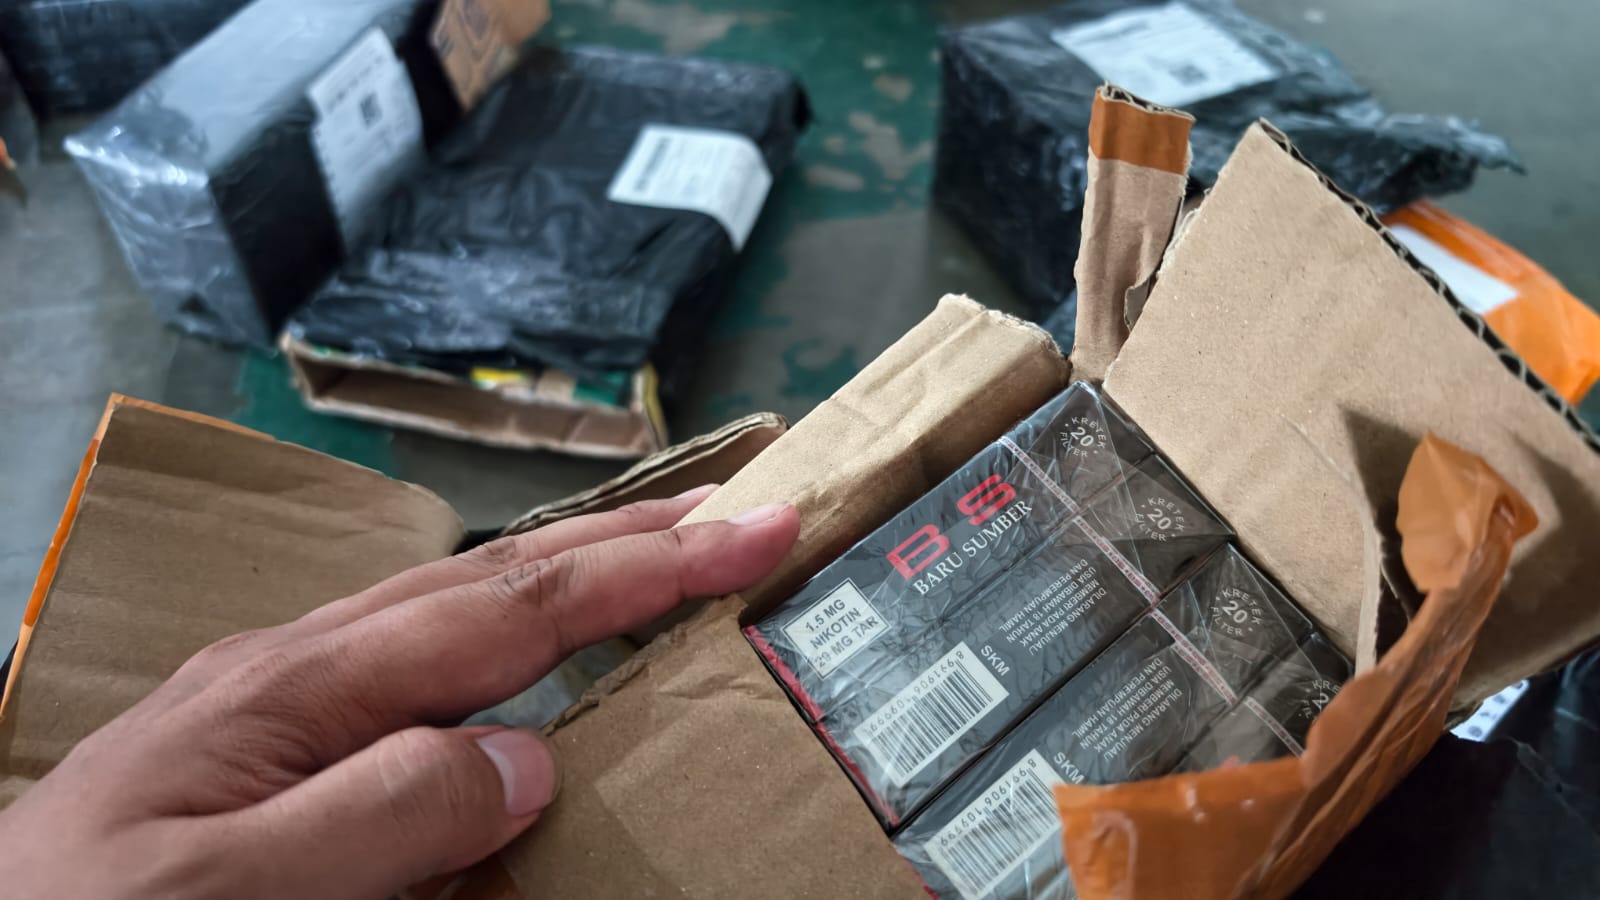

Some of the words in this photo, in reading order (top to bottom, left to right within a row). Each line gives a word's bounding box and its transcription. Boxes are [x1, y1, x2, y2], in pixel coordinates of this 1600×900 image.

[1070, 426, 1094, 447] 20
[1071, 416, 1107, 449] KRETEK
[1147, 497, 1185, 532] KRETEK
[1147, 508, 1172, 530] 20
[912, 552, 964, 595] BARU
[962, 500, 1033, 558] SUMBER
[1069, 559, 1088, 576] DAN
[1077, 566, 1096, 584] USIA
[1023, 574, 1072, 615] PEREMPUAN
[1042, 581, 1079, 613] DIBAWAH
[1064, 579, 1100, 610] MEMBERI
[1067, 587, 1107, 623] DILARANG
[1221, 588, 1263, 625] KRETEK
[805, 614, 825, 632] 1.5
[823, 599, 846, 617] MG
[999, 612, 1026, 633] HAMIL
[1032, 611, 1044, 621] 18
[1042, 608, 1065, 628] PADA
[1211, 606, 1244, 636] FILTER
[1222, 600, 1248, 624] 20
[809, 607, 862, 650] NIKOTIN
[814, 650, 832, 668] 29
[830, 635, 853, 656] MG
[850, 616, 879, 638] TAR
[1006, 618, 1035, 643] TAHUN
[1019, 625, 1044, 647] ANAK
[980, 645, 1010, 676] SKM
[1144, 657, 1163, 674] DAN
[1150, 665, 1172, 685] USIA
[1099, 673, 1146, 716] PEREMPUAN
[1117, 683, 1154, 716] DIBAWAH
[1139, 679, 1175, 712] MEMBERI
[1141, 688, 1183, 727] DILARANG
[1071, 712, 1101, 739] HAMIL
[1105, 715, 1118, 726] 18
[1119, 711, 1141, 733] PADA
[1079, 722, 1108, 750] TAHUN
[1093, 730, 1118, 753] ANAK
[1027, 758, 1037, 769] 8
[1053, 751, 1085, 784] SKM
